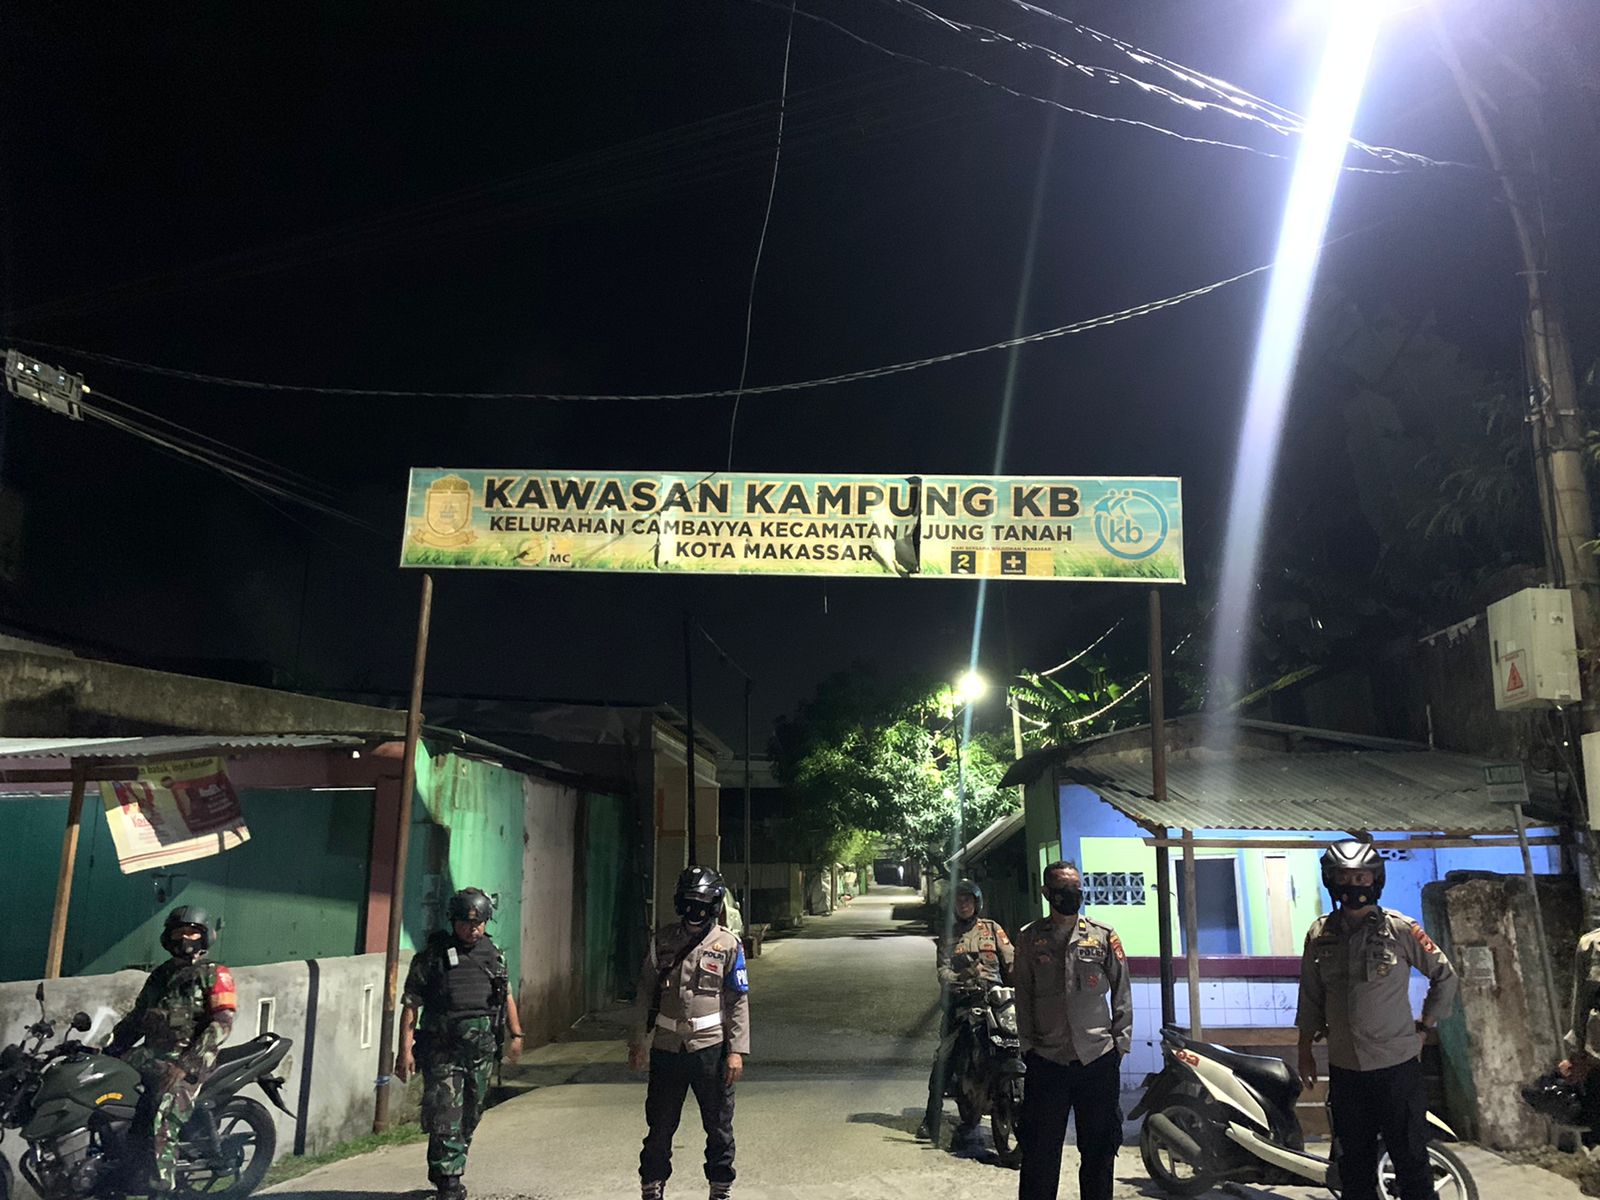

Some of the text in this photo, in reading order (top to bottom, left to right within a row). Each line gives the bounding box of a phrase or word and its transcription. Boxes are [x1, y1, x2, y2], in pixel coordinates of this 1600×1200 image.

[484, 477, 1080, 518] KAWASAN KAMPUNG KB
[489, 516, 625, 535] KELURAHAN
[631, 518, 753, 538] CAMBAYYA
[760, 521, 897, 540] KECAMATAN
[991, 525, 1072, 541] TANAH
[675, 541, 873, 562] KOTA MAKASSAR
